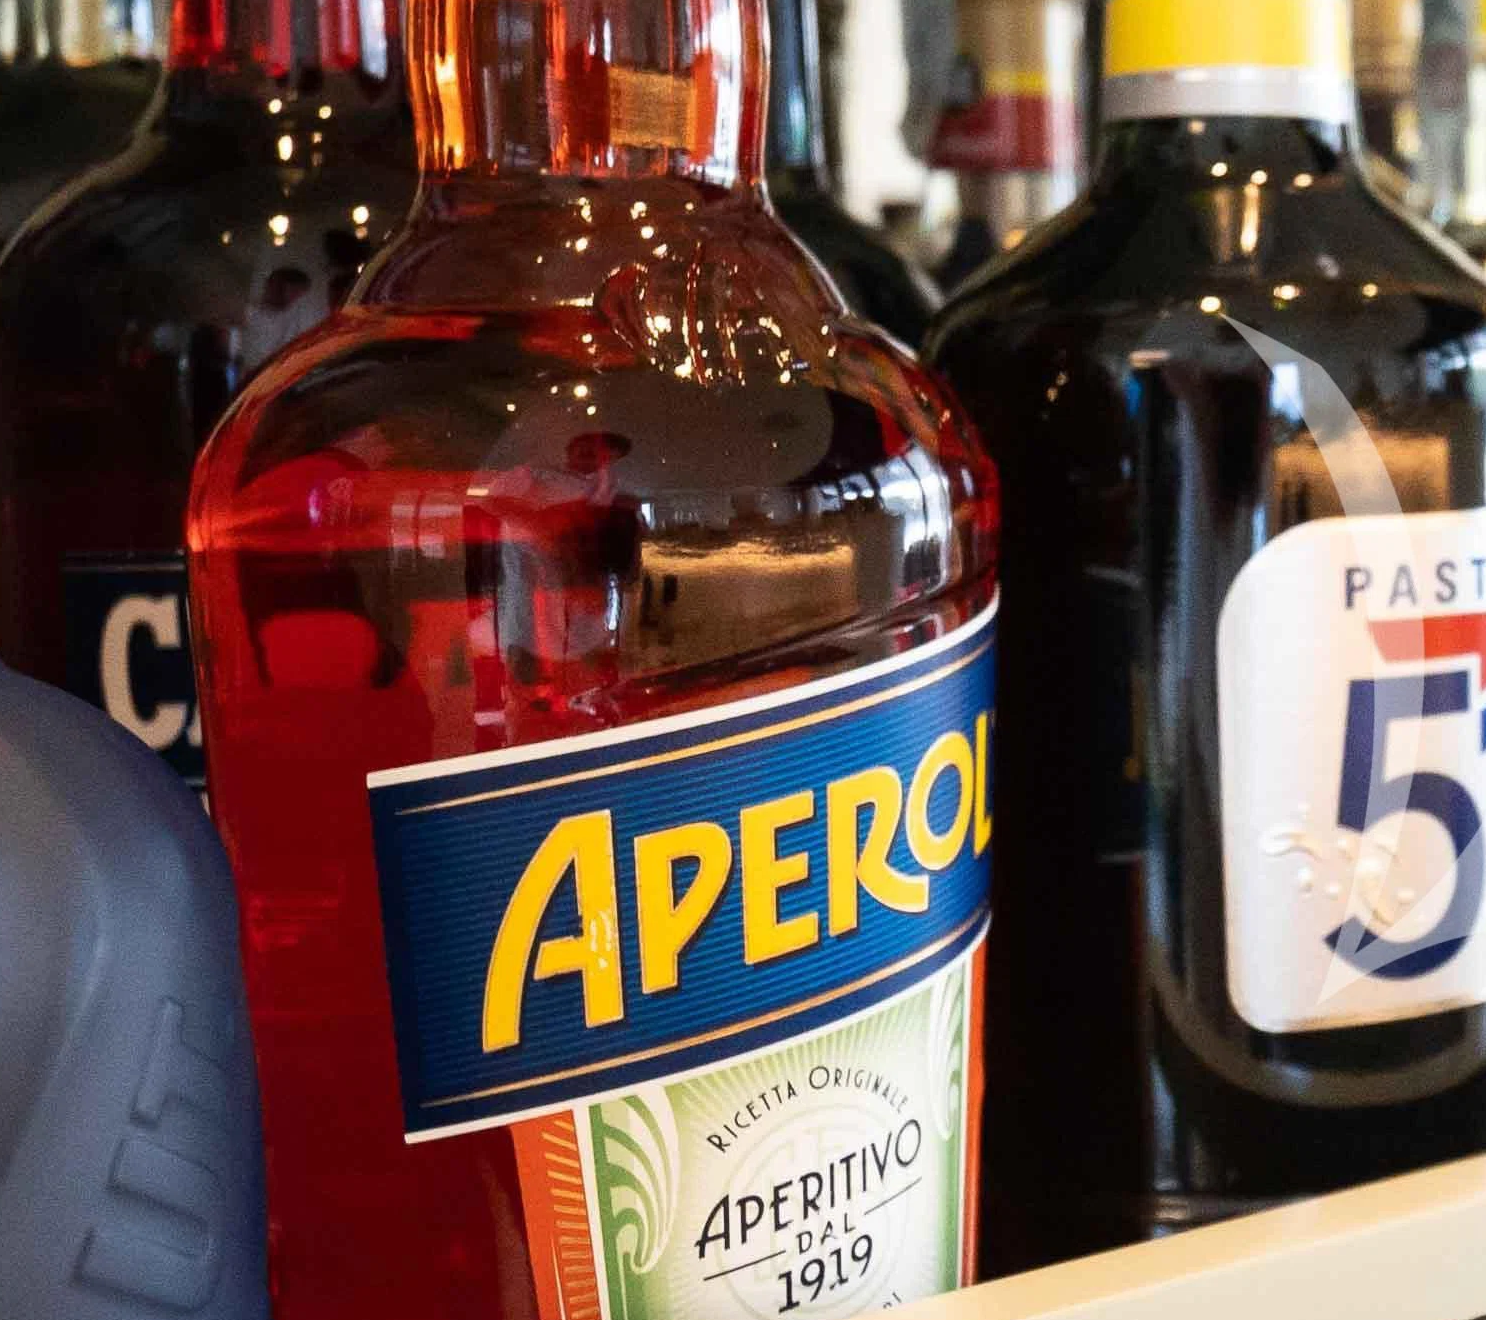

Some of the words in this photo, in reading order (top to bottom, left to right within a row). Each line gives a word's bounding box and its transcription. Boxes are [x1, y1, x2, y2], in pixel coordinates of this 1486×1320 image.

[481, 719, 994, 1054] APEROL
[706, 1079, 798, 1154] RICETTA
[808, 1066, 909, 1114] ORIGINALE
[694, 1118, 922, 1260] APERITIVO
[777, 1233, 874, 1314] 1919
[795, 1212, 857, 1255] DAL
